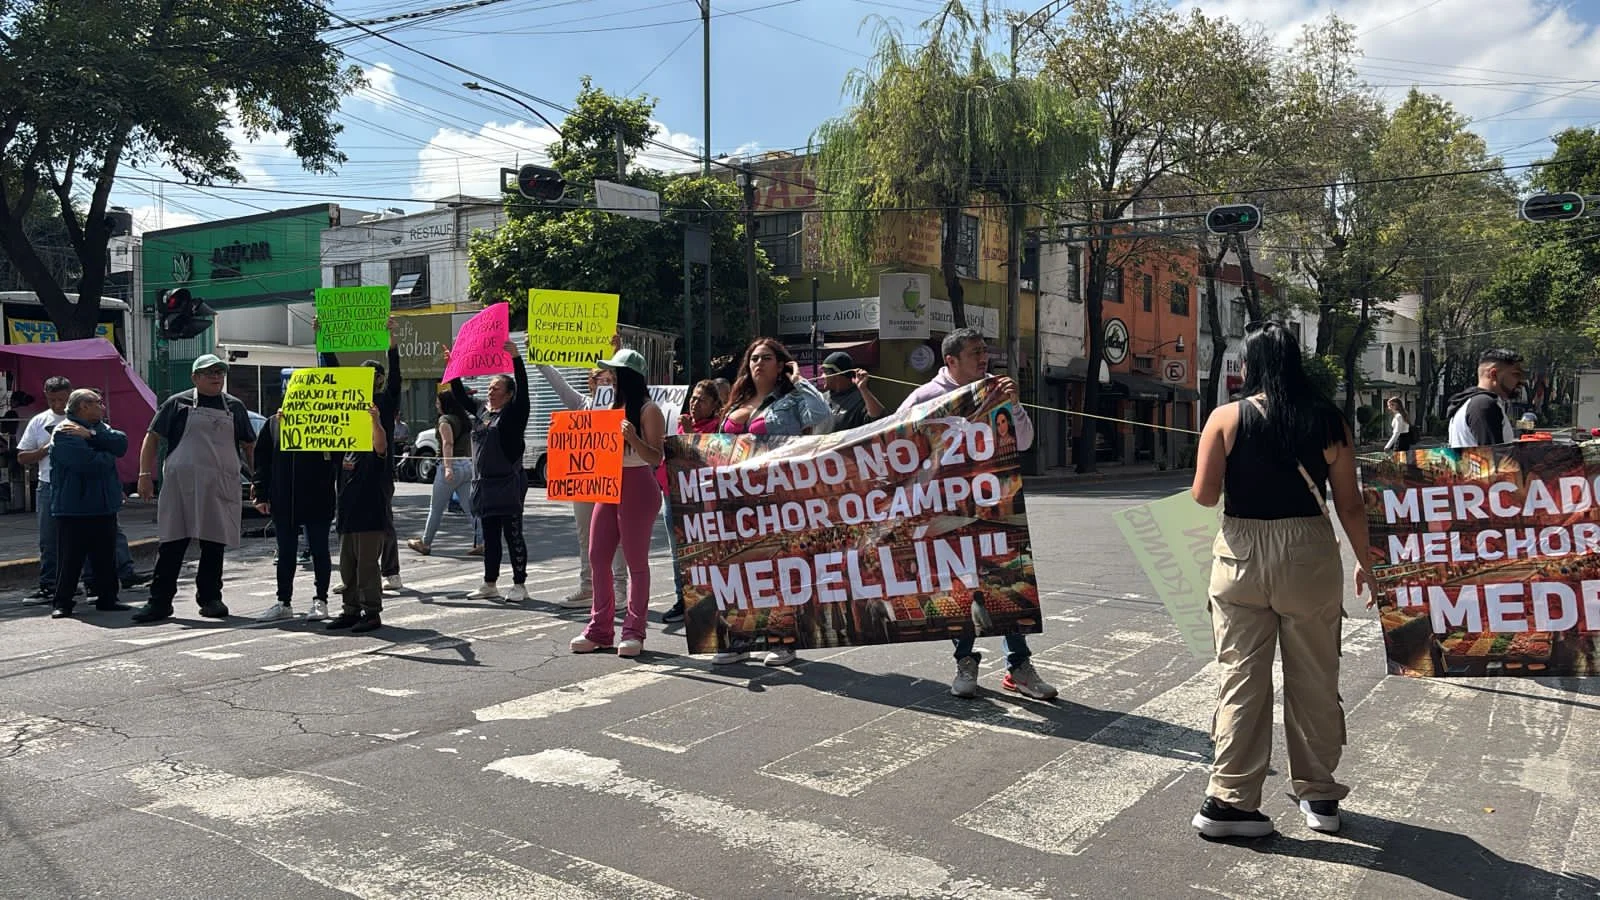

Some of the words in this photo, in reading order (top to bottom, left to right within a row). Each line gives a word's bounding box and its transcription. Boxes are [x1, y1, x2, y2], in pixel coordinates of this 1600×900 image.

[532, 293, 609, 319] CONCEJALES
[536, 319, 583, 332] RESPETEN
[586, 322, 602, 333] LOS
[529, 347, 543, 361] NO
[322, 373, 337, 385] AL
[327, 389, 338, 399] DE
[342, 389, 365, 402] MIS
[595, 388, 613, 407] LO
[568, 412, 592, 430] SON
[282, 427, 302, 449] NO
[303, 425, 343, 436] ABASTO
[305, 437, 357, 449] POPULAR
[550, 431, 618, 453] DIPUTADOS
[569, 451, 595, 473] NO
[678, 451, 847, 504] MERCADO
[852, 438, 932, 481] NO.
[940, 421, 995, 467] 20
[547, 476, 619, 498] COMERCIANTES
[683, 499, 835, 544] MELCHOR
[839, 472, 1001, 525] OCAMPO
[1384, 475, 1600, 525] MERCAD
[691, 525, 1008, 611] "MEDELLÍN"
